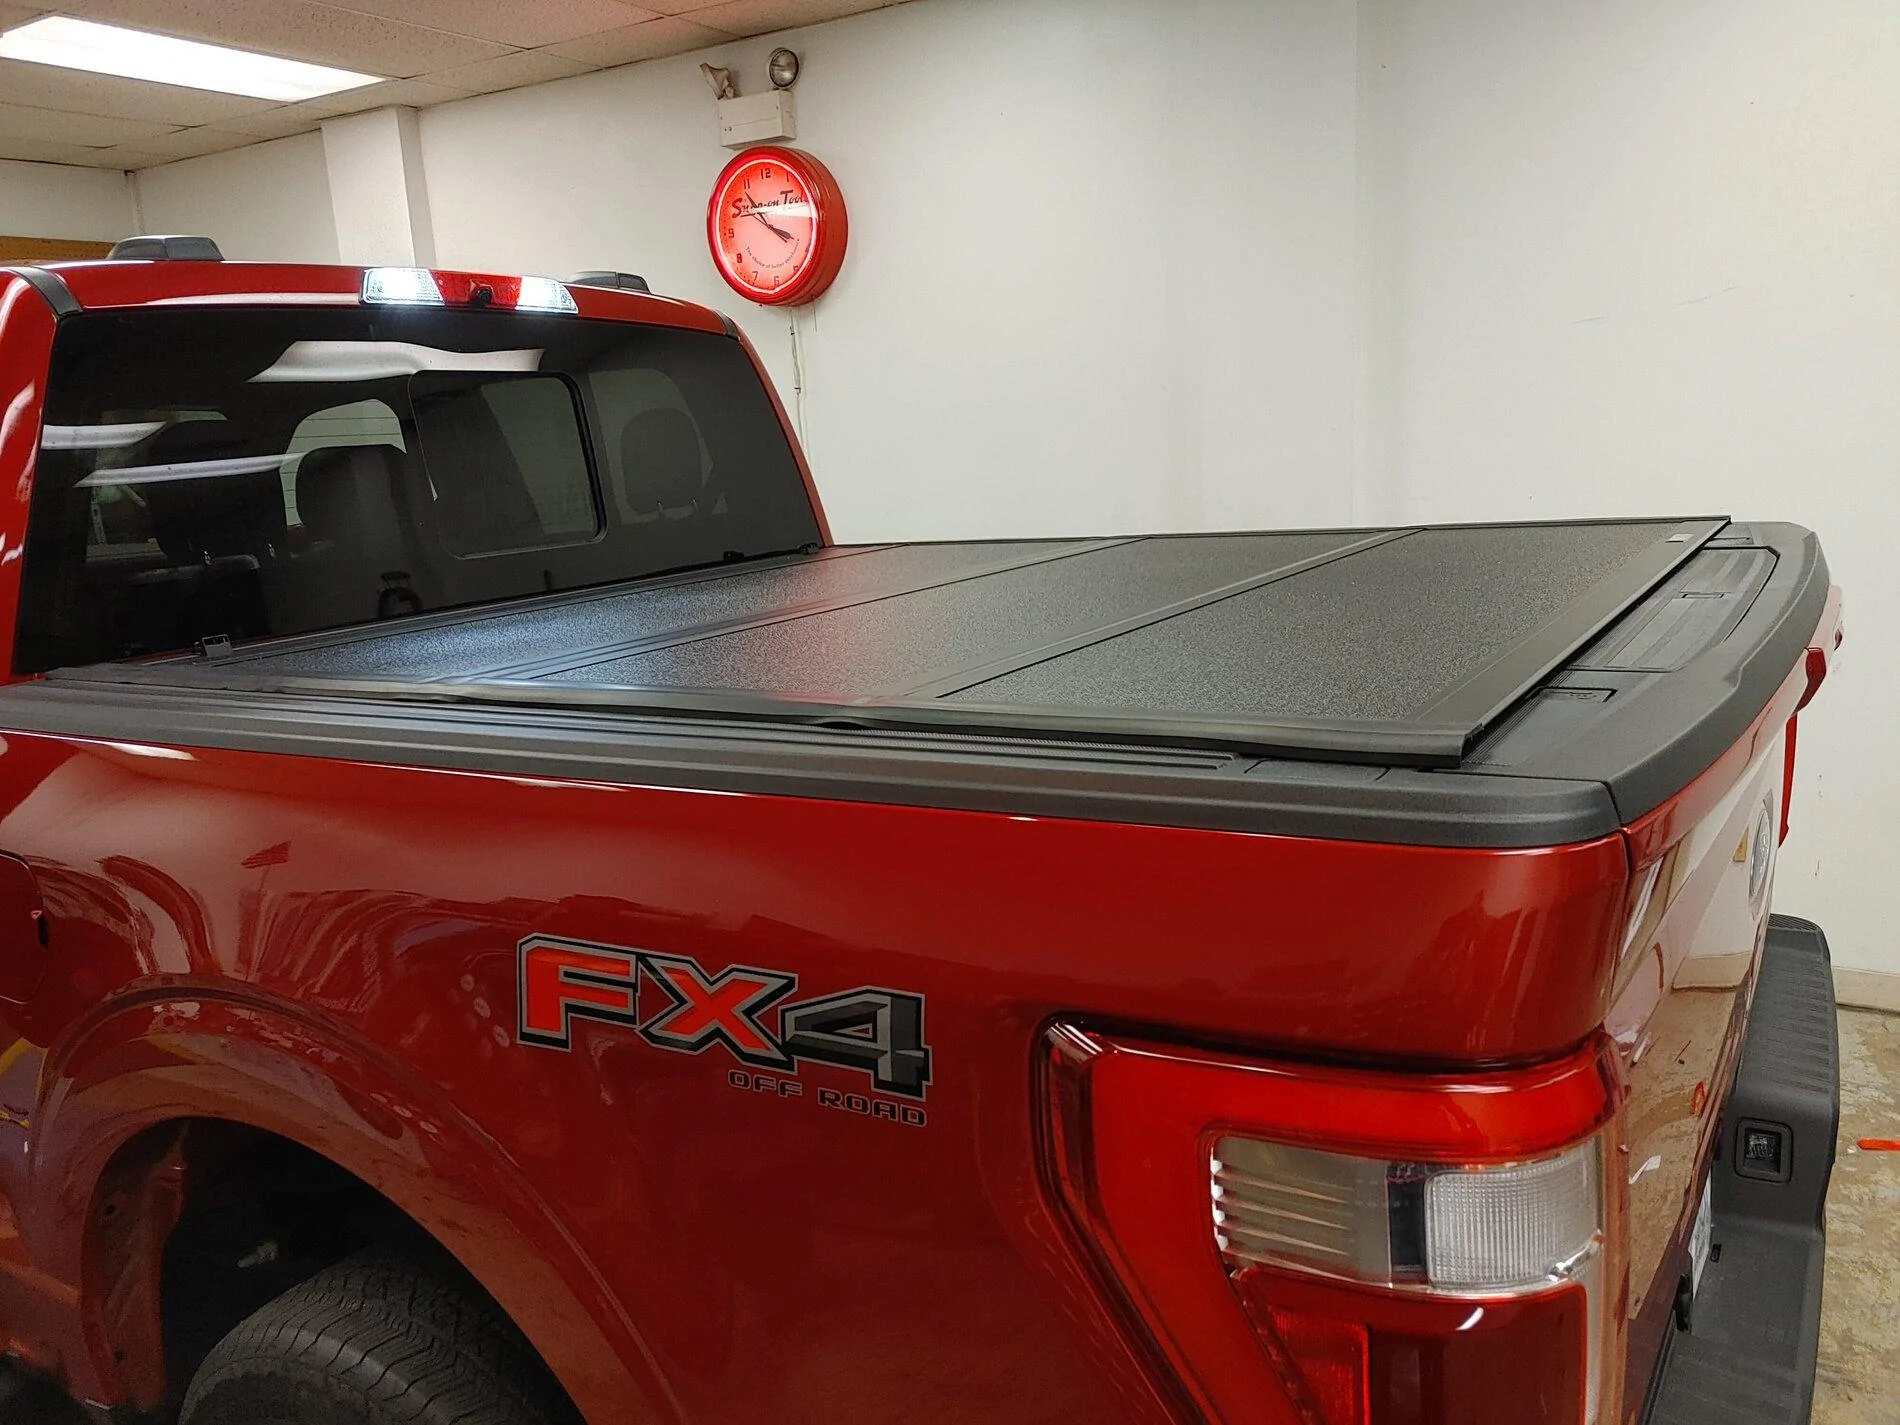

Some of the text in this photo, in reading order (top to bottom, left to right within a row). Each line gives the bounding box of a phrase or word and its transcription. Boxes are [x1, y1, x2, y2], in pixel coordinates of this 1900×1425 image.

[760, 167, 772, 179] 12
[743, 179, 751, 189] 11
[780, 189, 804, 205] Tool
[728, 228, 735, 238] 9
[736, 253, 743, 264] 8
[752, 270, 759, 281] 7
[773, 275, 780, 286] 6
[517, 933, 932, 1100] FX4
[728, 1069, 927, 1127] OFF ROAD
